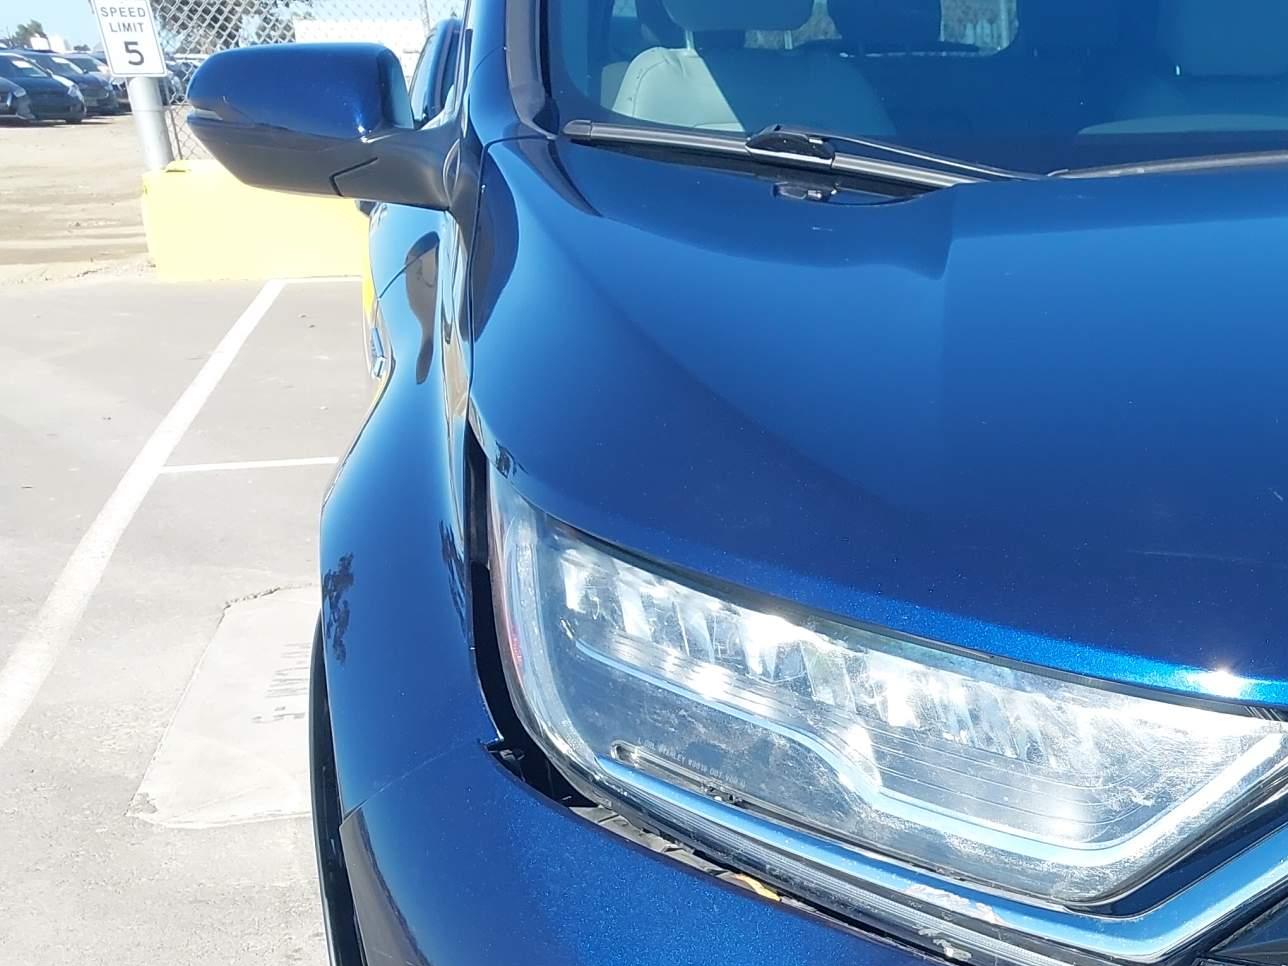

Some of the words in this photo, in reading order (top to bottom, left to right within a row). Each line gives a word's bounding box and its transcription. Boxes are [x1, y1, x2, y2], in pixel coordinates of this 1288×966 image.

[100, 6, 146, 17] SPEED
[108, 22, 144, 33] LIMIT
[124, 41, 145, 66] 5
